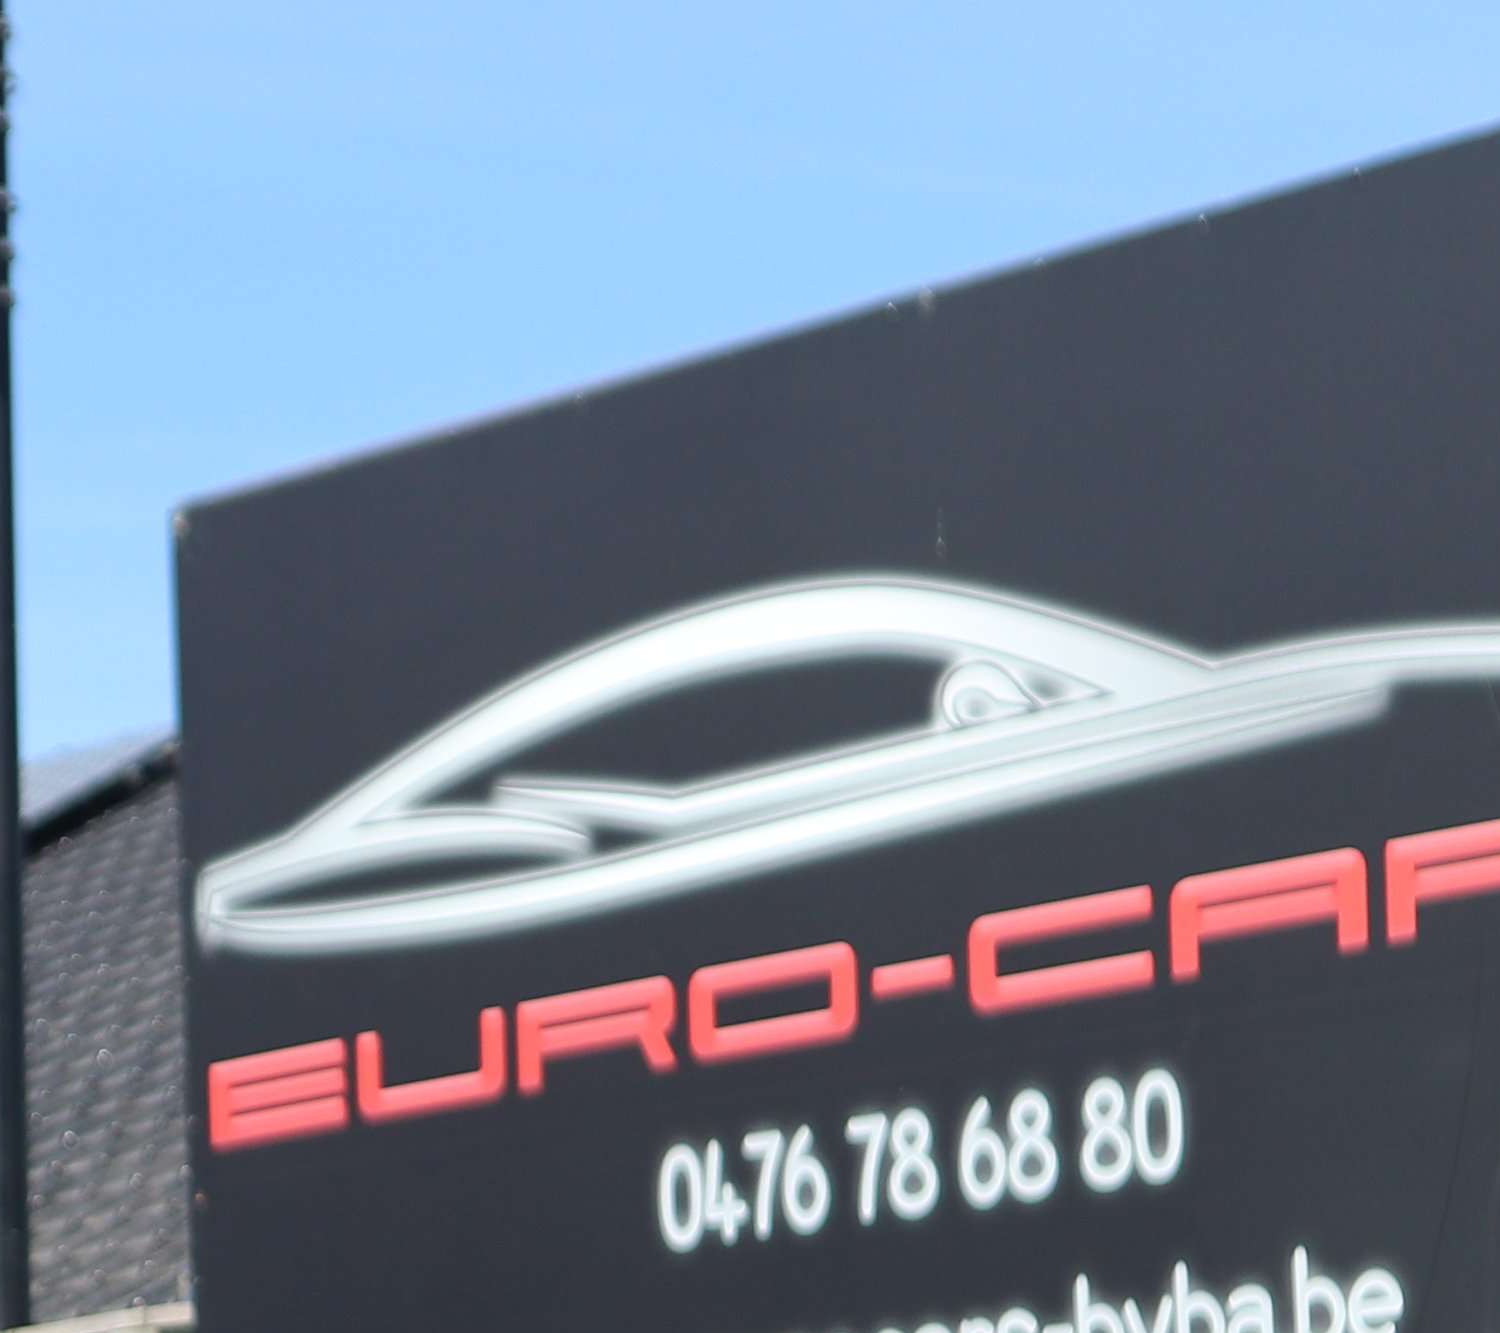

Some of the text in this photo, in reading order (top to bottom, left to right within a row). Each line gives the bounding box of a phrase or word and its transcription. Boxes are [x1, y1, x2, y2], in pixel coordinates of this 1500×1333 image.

[656, 1067, 1185, 1253] 0476 78 68 80
